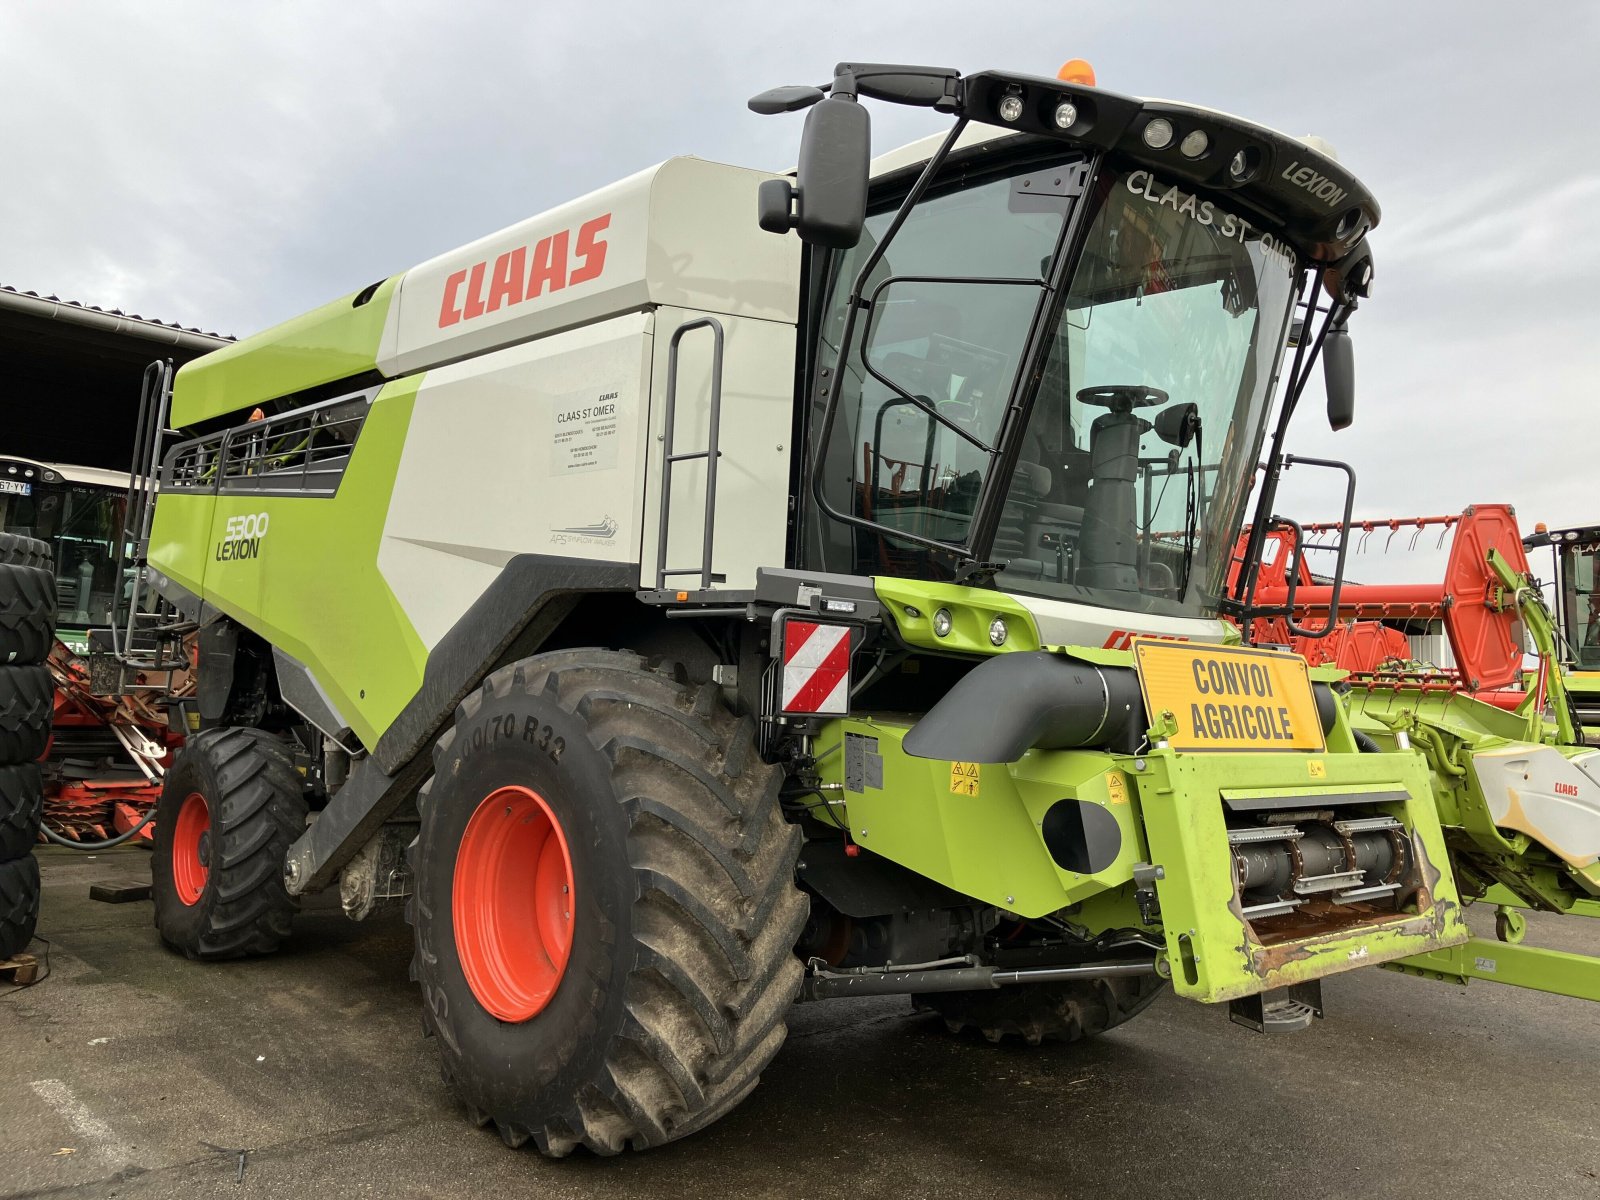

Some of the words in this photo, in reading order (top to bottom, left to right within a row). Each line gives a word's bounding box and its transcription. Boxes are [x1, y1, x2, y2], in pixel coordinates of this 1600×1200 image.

[1281, 161, 1348, 207] LEXION
[1126, 170, 1216, 226] CLAAS
[1220, 213, 1252, 244] ST
[1260, 232, 1297, 277] OMER
[438, 212, 612, 329] CLAAS
[557, 410, 581, 424] CLAAS
[582, 408, 592, 419] ST
[593, 403, 615, 417] OMER
[598, 391, 619, 402] CLAAS
[224, 511, 270, 542] 5300
[215, 537, 261, 562] LEXION
[1191, 658, 1274, 698] CONVOI
[1190, 703, 1294, 740] AGRICOLE
[1554, 782, 1578, 797] CLAAS
